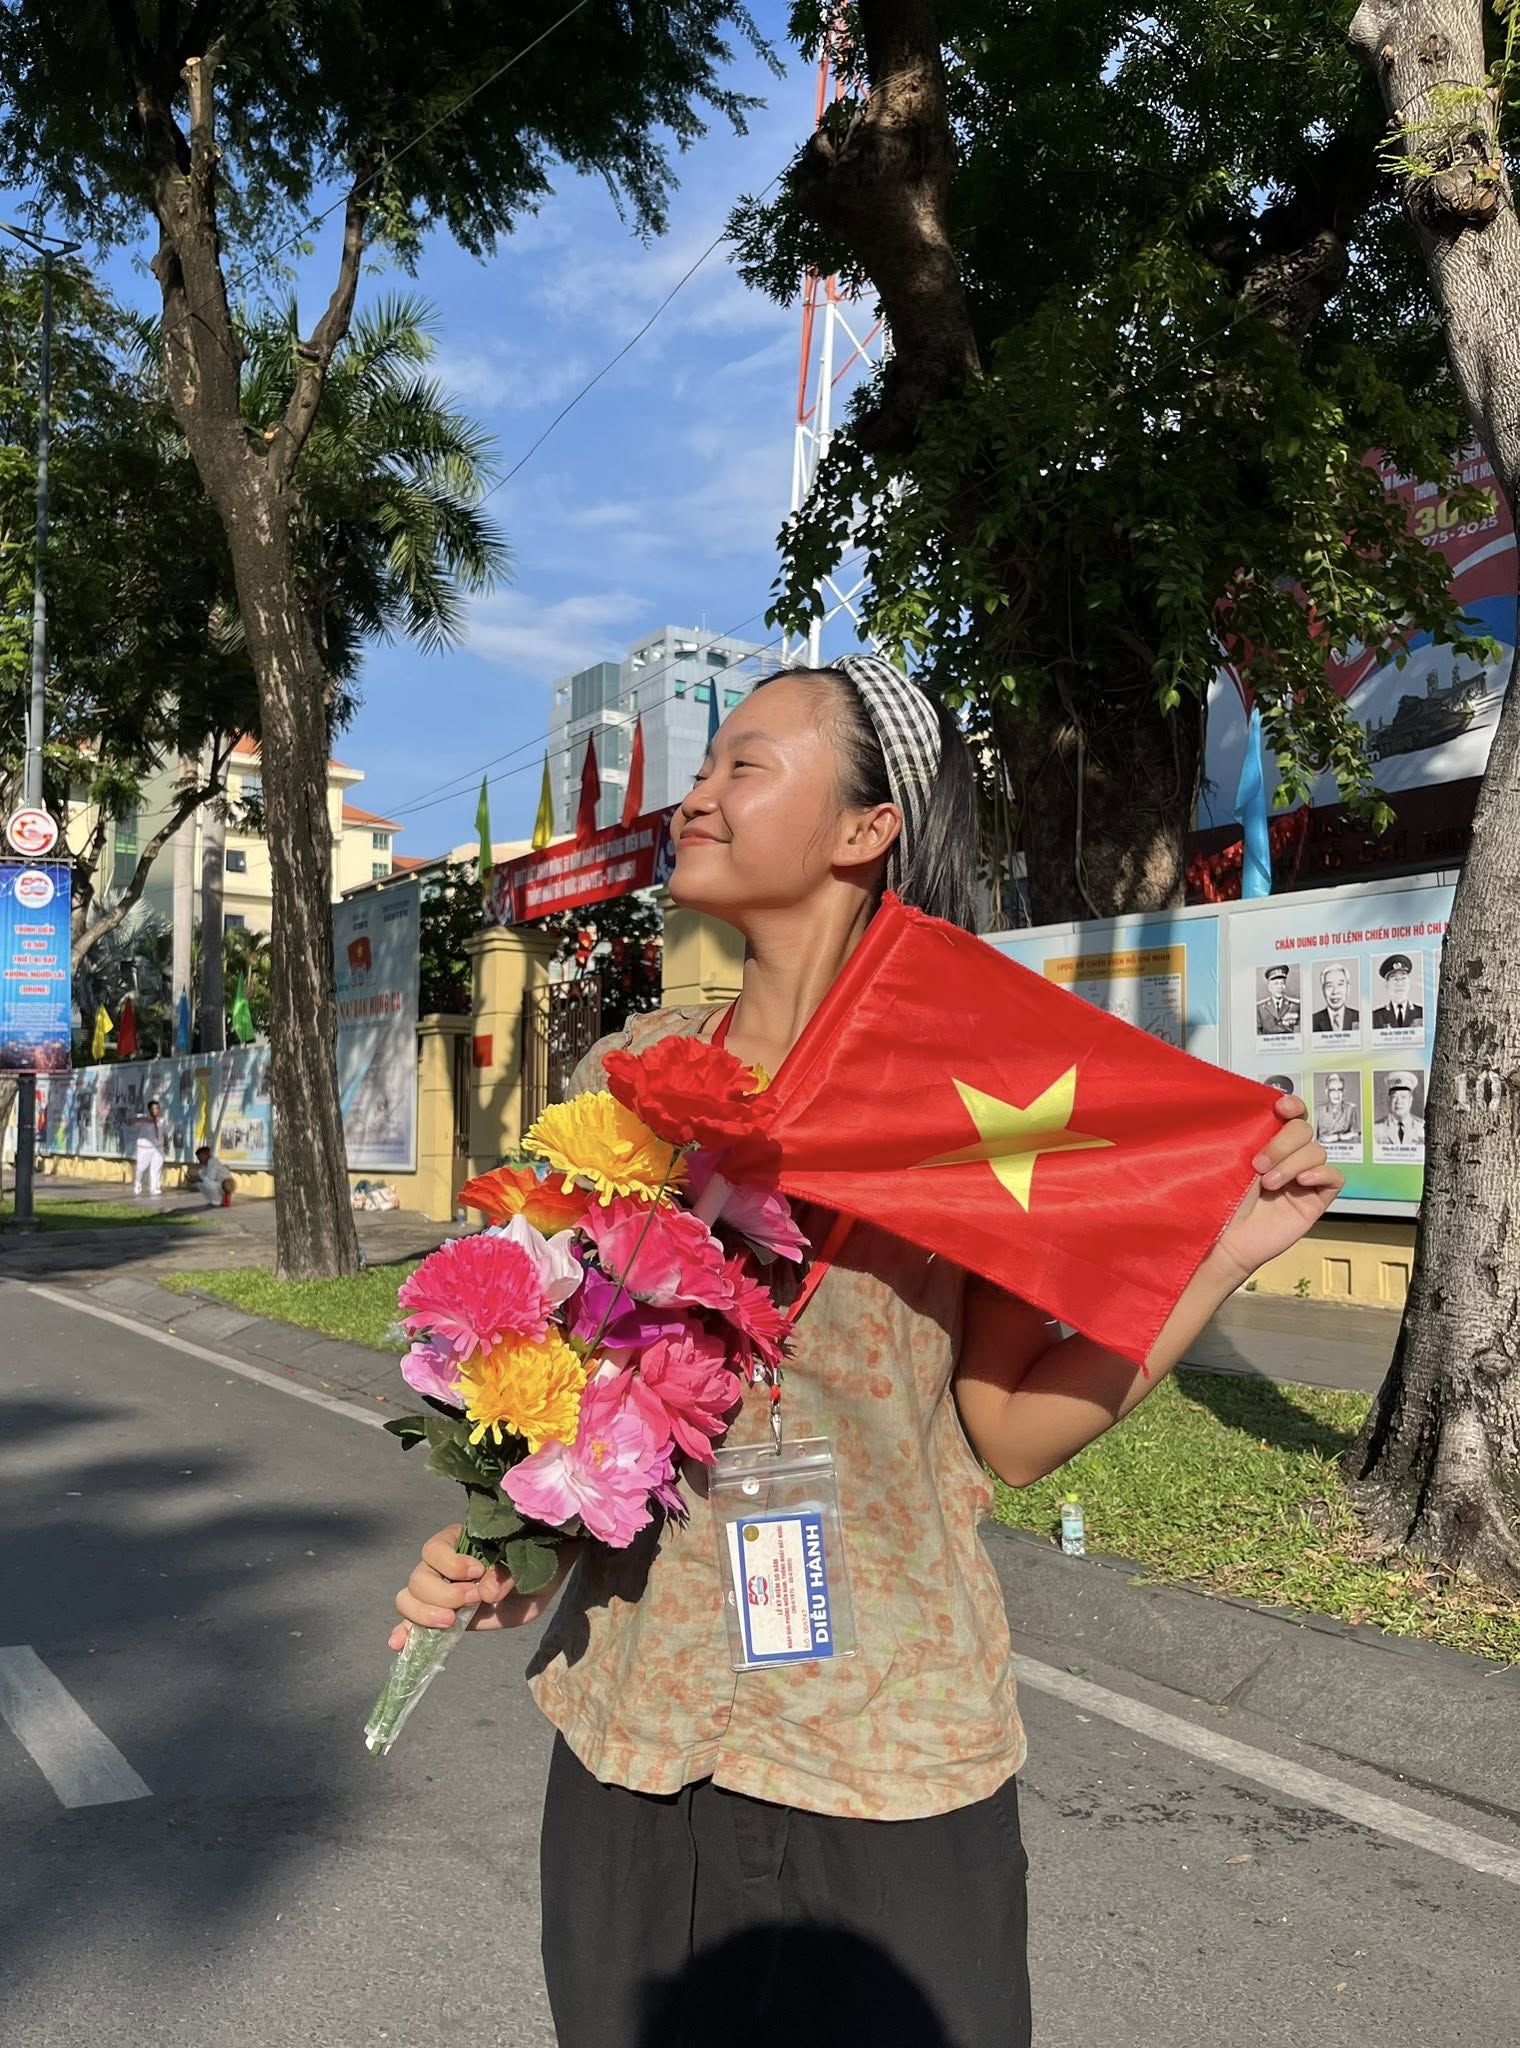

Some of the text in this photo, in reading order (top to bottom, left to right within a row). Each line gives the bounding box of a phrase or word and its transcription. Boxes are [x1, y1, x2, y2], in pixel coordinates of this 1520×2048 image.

[1275, 937, 1295, 950] CHÂN
[1297, 935, 1317, 948] DUNG
[1319, 933, 1329, 948] BỘ
[1331, 933, 1342, 945] TƯ
[1343, 931, 1363, 946] LỆNH
[1365, 925, 1389, 941] CHIẾN
[1391, 925, 1411, 941] DỊCH
[1413, 921, 1425, 936] HỒ
[1427, 920, 1442, 935] CHÍ
[805, 1524, 824, 1588] HÀNH
